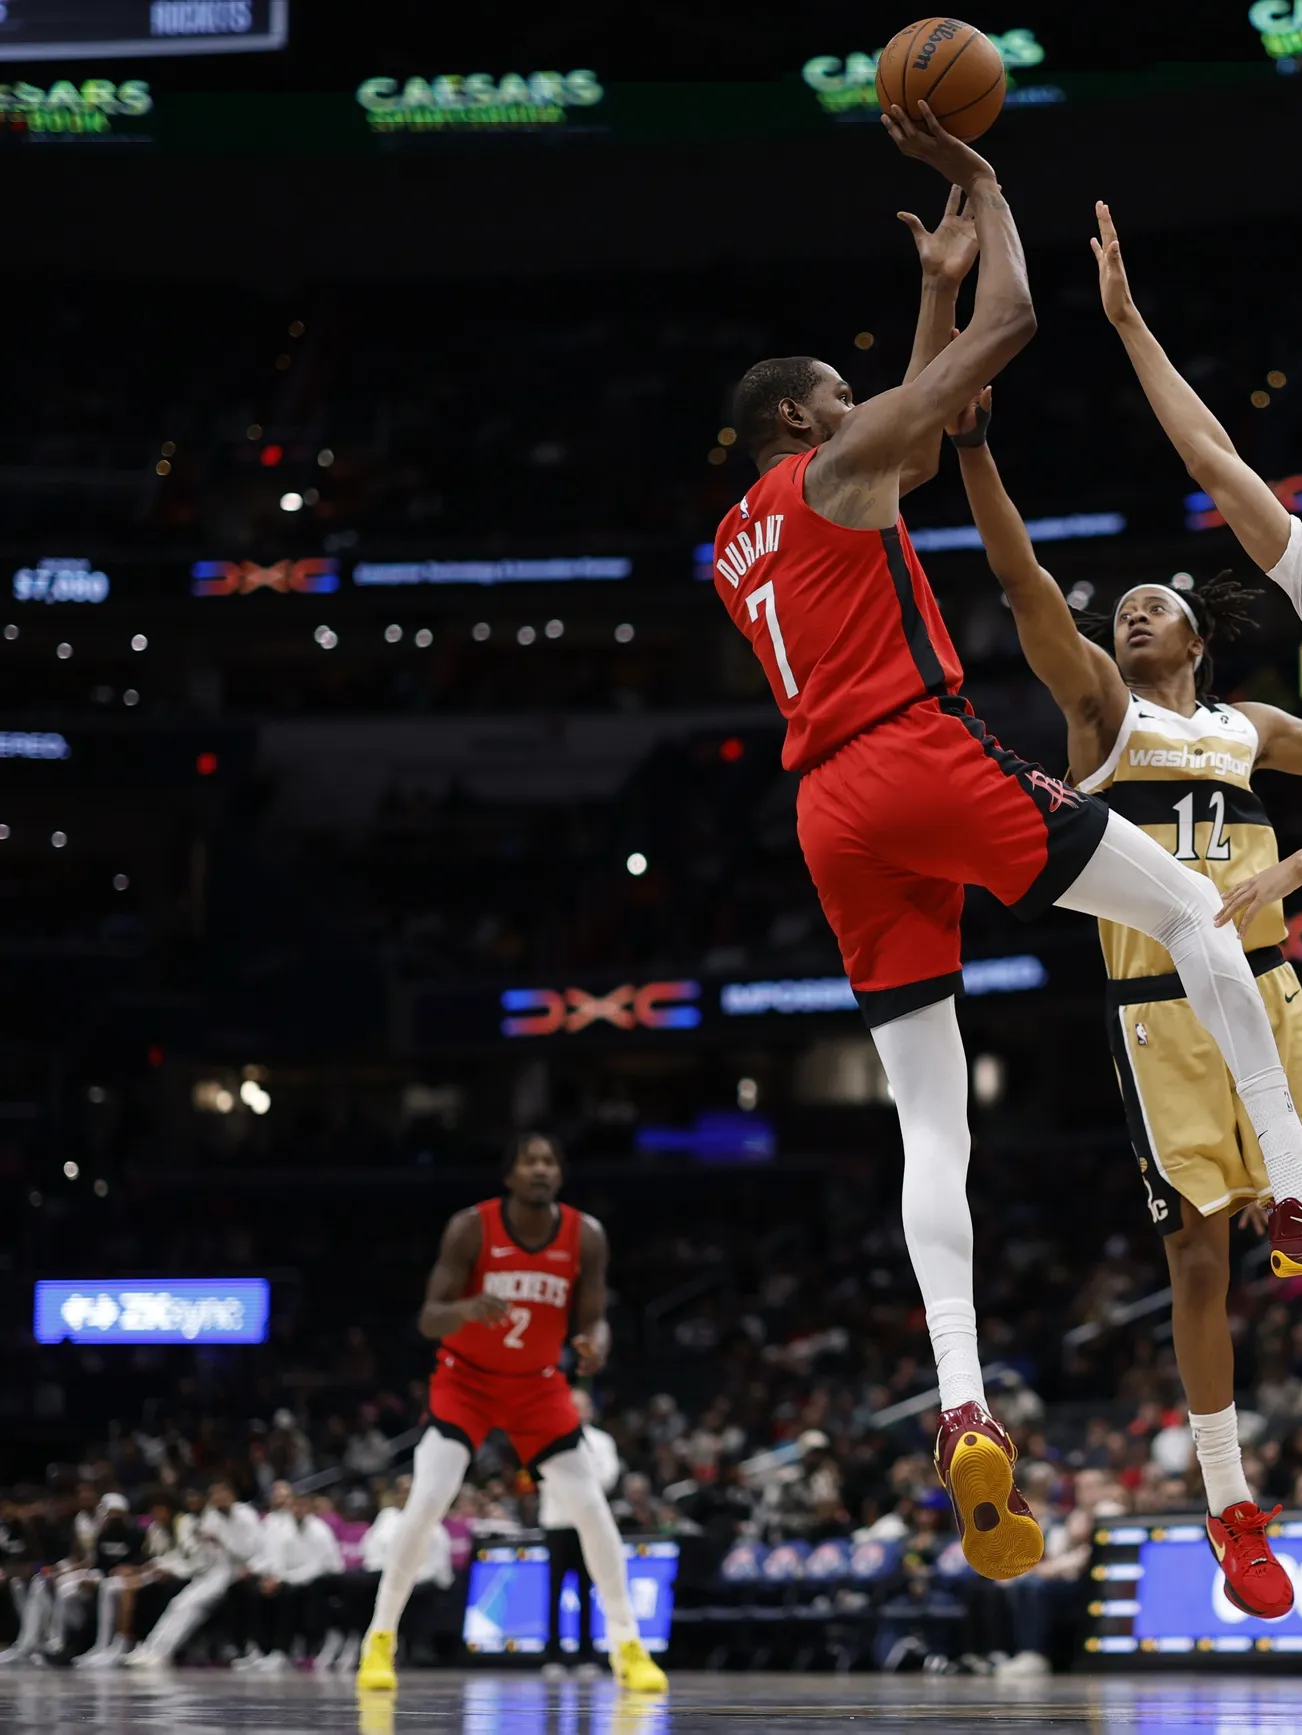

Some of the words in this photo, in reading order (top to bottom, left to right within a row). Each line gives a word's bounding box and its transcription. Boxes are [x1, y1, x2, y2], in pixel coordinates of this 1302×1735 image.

[356, 70, 604, 113] CAESARS
[716, 514, 784, 589] DURANT
[745, 580, 799, 699] 7
[1129, 744, 1251, 776] washington
[1172, 791, 1231, 861] 12
[503, 1308, 532, 1349] 2
